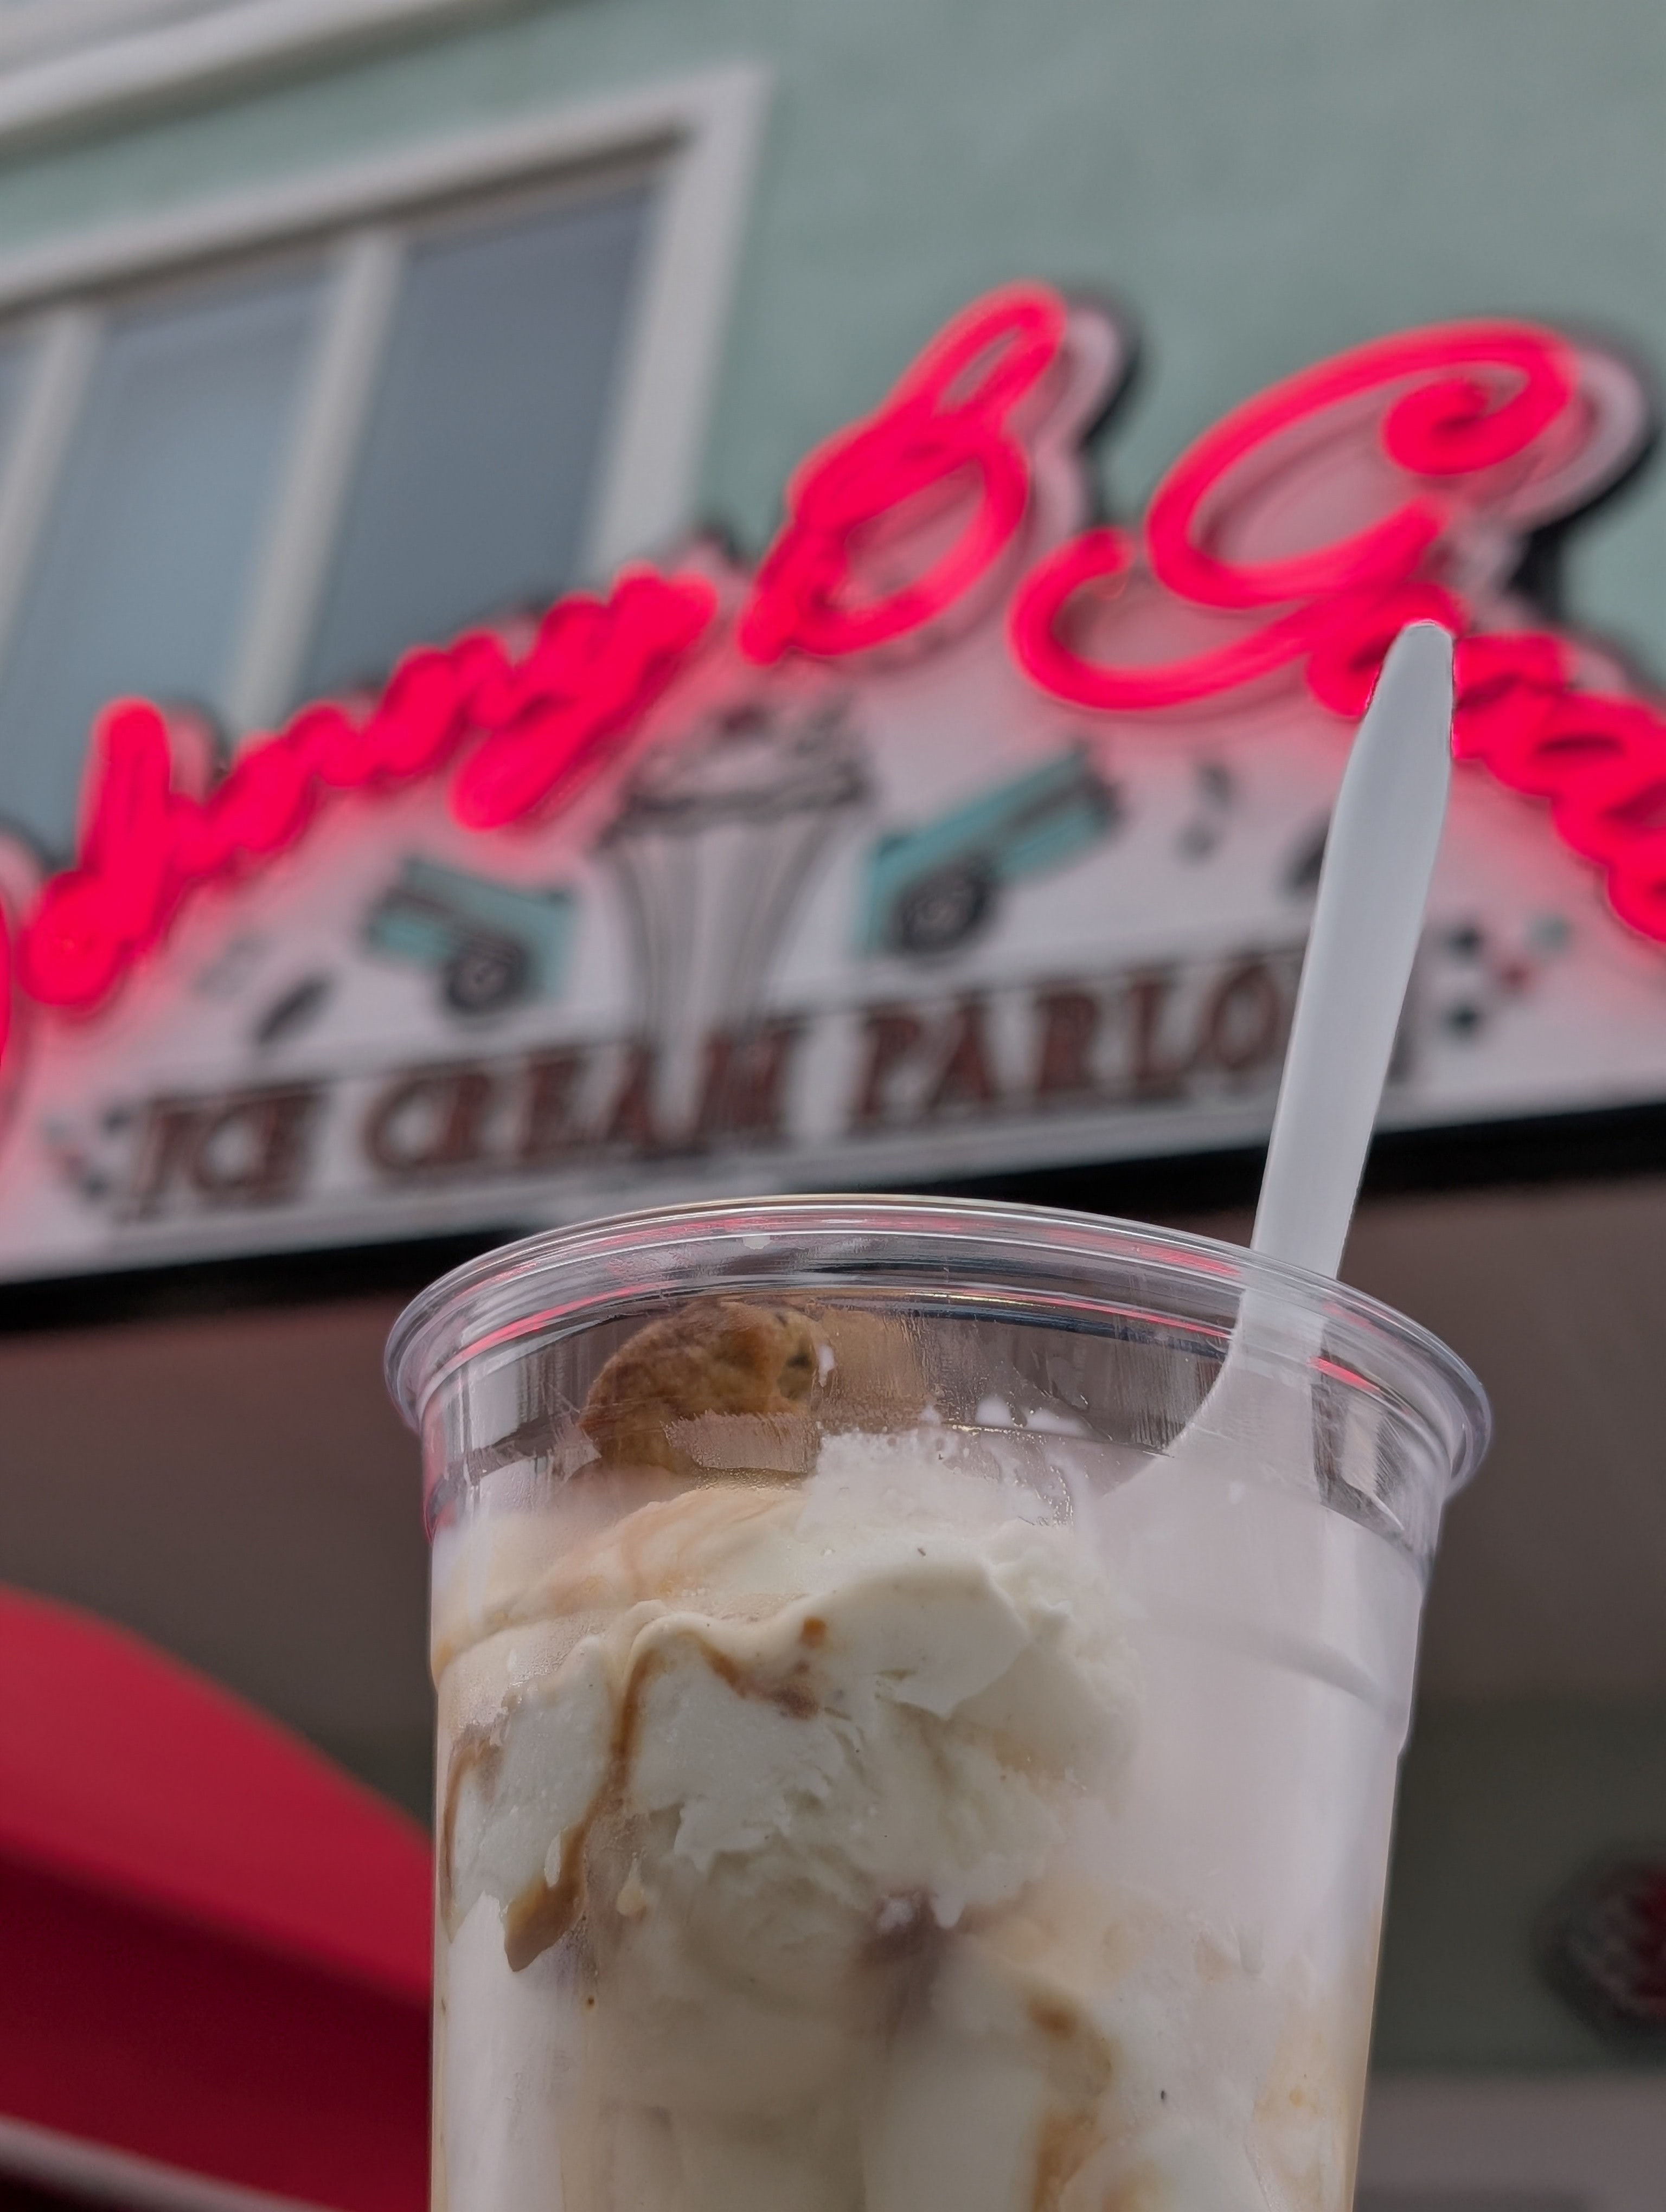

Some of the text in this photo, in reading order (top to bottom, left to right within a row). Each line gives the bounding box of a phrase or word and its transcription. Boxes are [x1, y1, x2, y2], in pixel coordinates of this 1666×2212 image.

[111, 949, 1420, 1224] ICE CREAM PARLO
